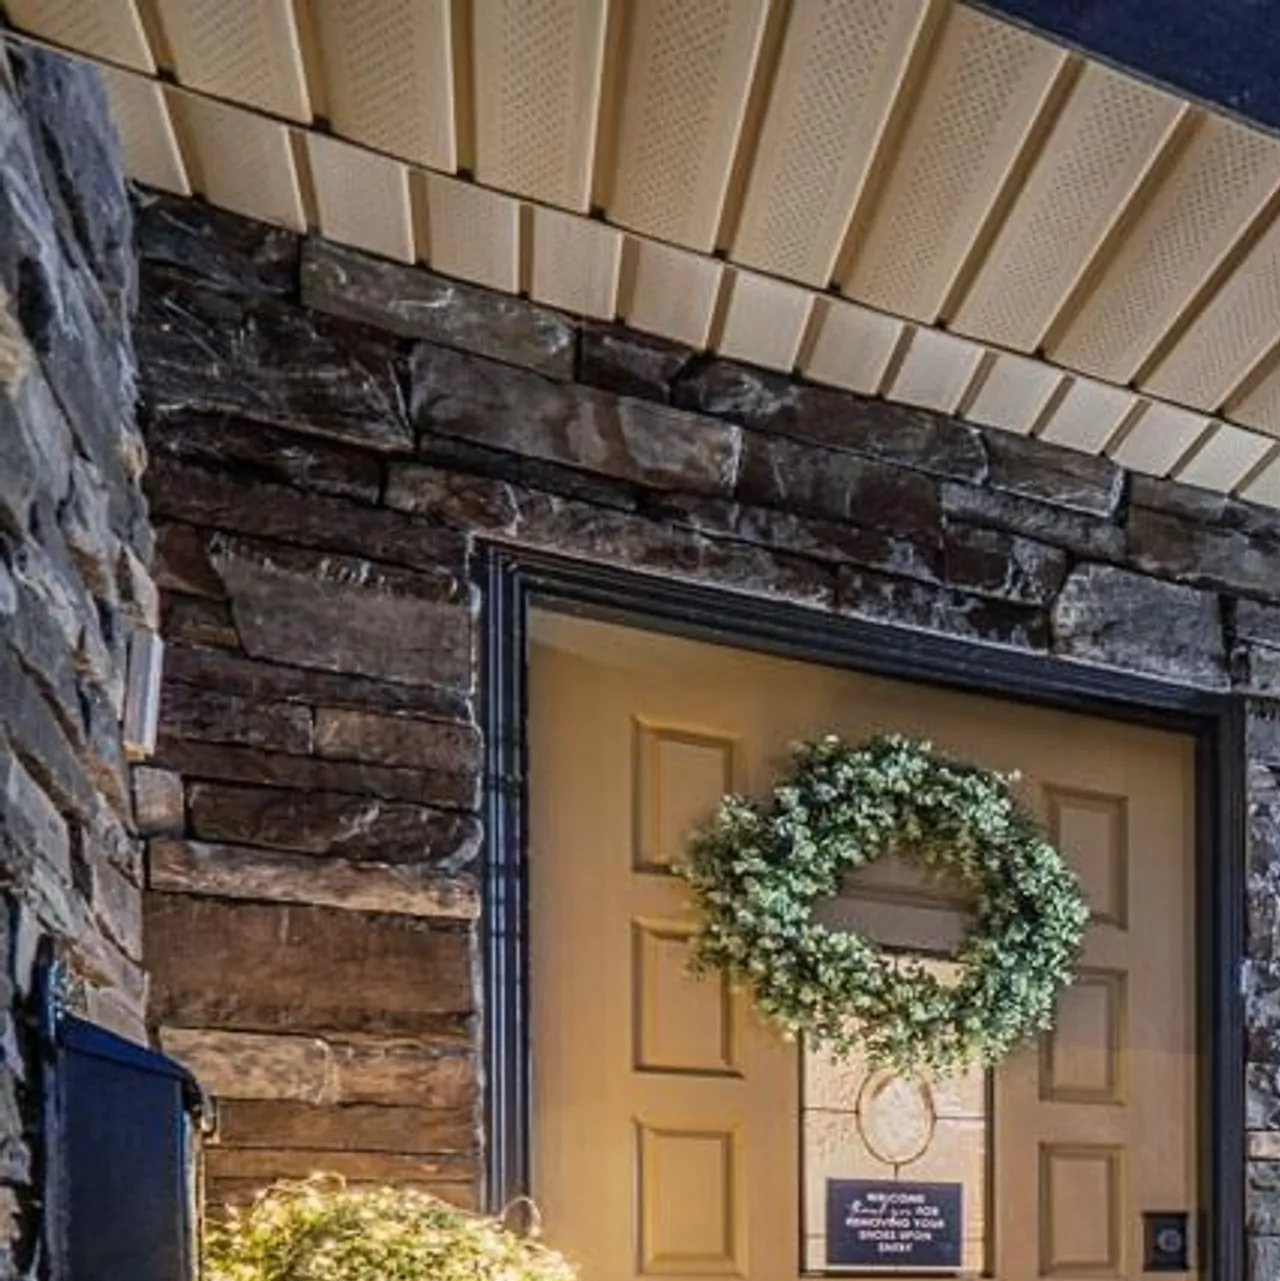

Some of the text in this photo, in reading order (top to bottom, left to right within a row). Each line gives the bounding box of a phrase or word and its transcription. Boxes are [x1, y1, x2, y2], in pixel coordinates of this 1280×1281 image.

[866, 1192, 925, 1204] WELCOME
[915, 1206, 939, 1217] FOR
[845, 1217, 945, 1230] REMOVING YOUR
[858, 1230, 932, 1241] SHOES UPON
[878, 1242, 914, 1253] ENTRY
